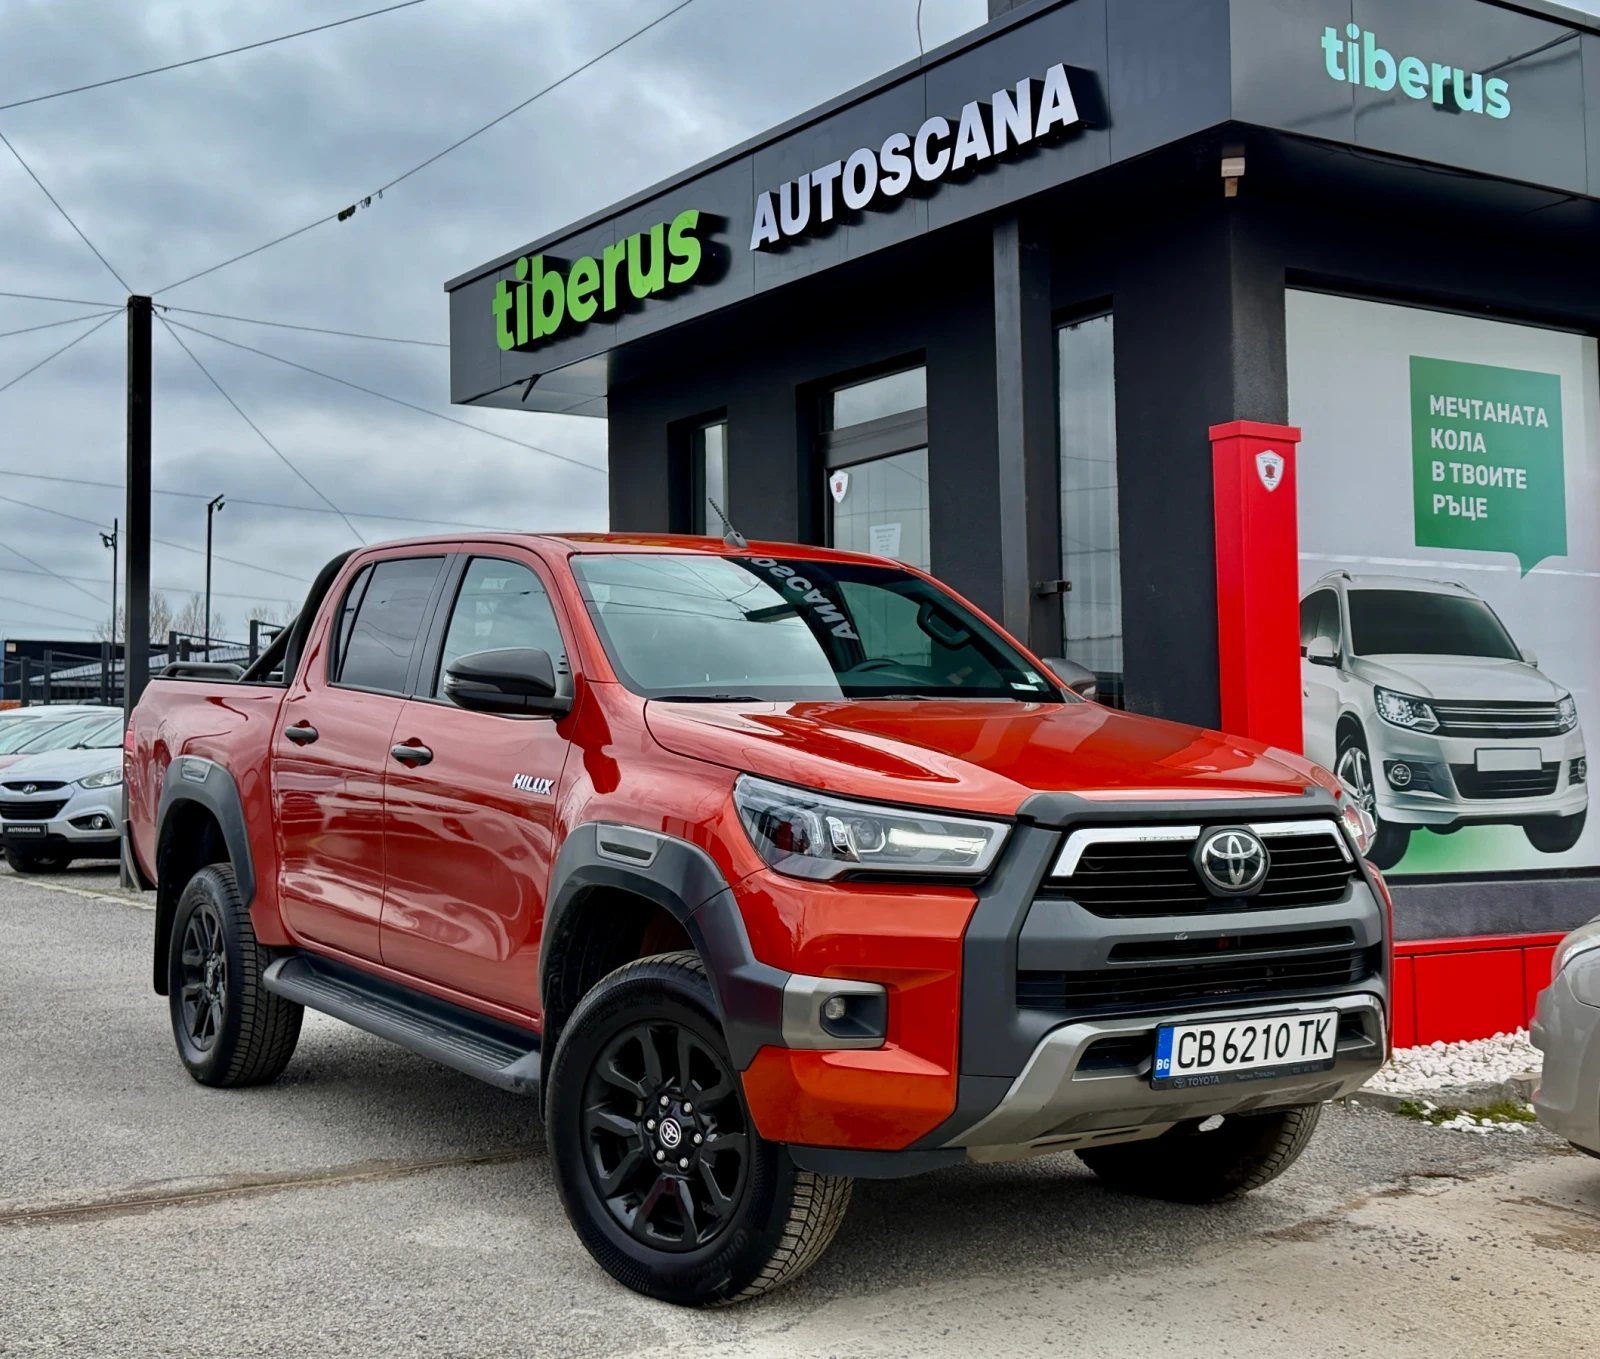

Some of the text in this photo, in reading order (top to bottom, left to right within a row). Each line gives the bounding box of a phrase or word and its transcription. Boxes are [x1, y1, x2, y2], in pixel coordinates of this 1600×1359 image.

[1321, 23, 1511, 119] tiberus
[749, 63, 1080, 251] AUTOSCANA
[492, 209, 703, 352] tiberus
[1429, 394, 1549, 428] МЕЧТАНАТА
[1430, 427, 1487, 453] КОЛА
[1431, 460, 1528, 489] В ТВОИТЕ
[1433, 493, 1488, 521] РЪЦЕ
[512, 773, 555, 796] HILUX
[1177, 1018, 1332, 1069] CB 6210 TK
[1156, 1059, 1170, 1071] BG
[1187, 1075, 1220, 1086] TOYOTA
